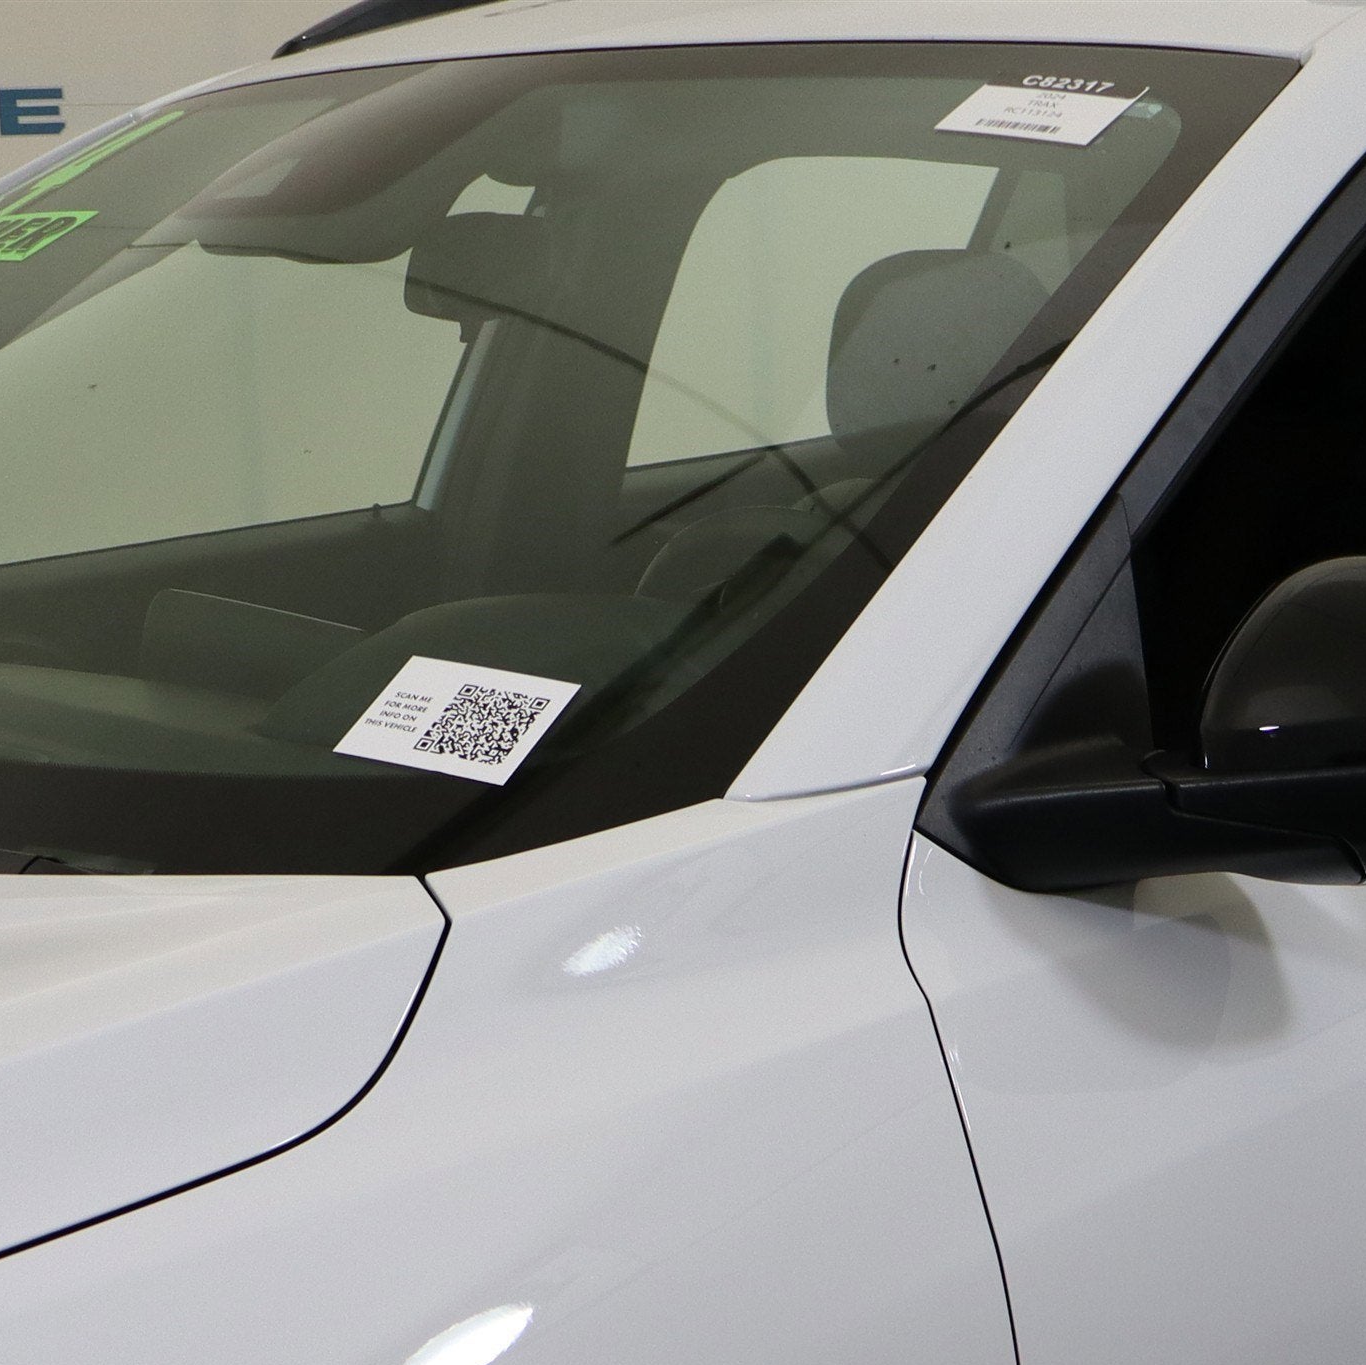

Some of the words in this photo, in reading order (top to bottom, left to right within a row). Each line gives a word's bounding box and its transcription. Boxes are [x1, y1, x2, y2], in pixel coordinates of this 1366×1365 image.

[1022, 74, 1114, 93] C82317
[395, 691, 419, 701] SCAN
[384, 700, 402, 708] FOR
[403, 703, 428, 713] MORE
[380, 710, 401, 719] INFO
[365, 718, 382, 726] THIS
[384, 721, 417, 733] VEHICLE
